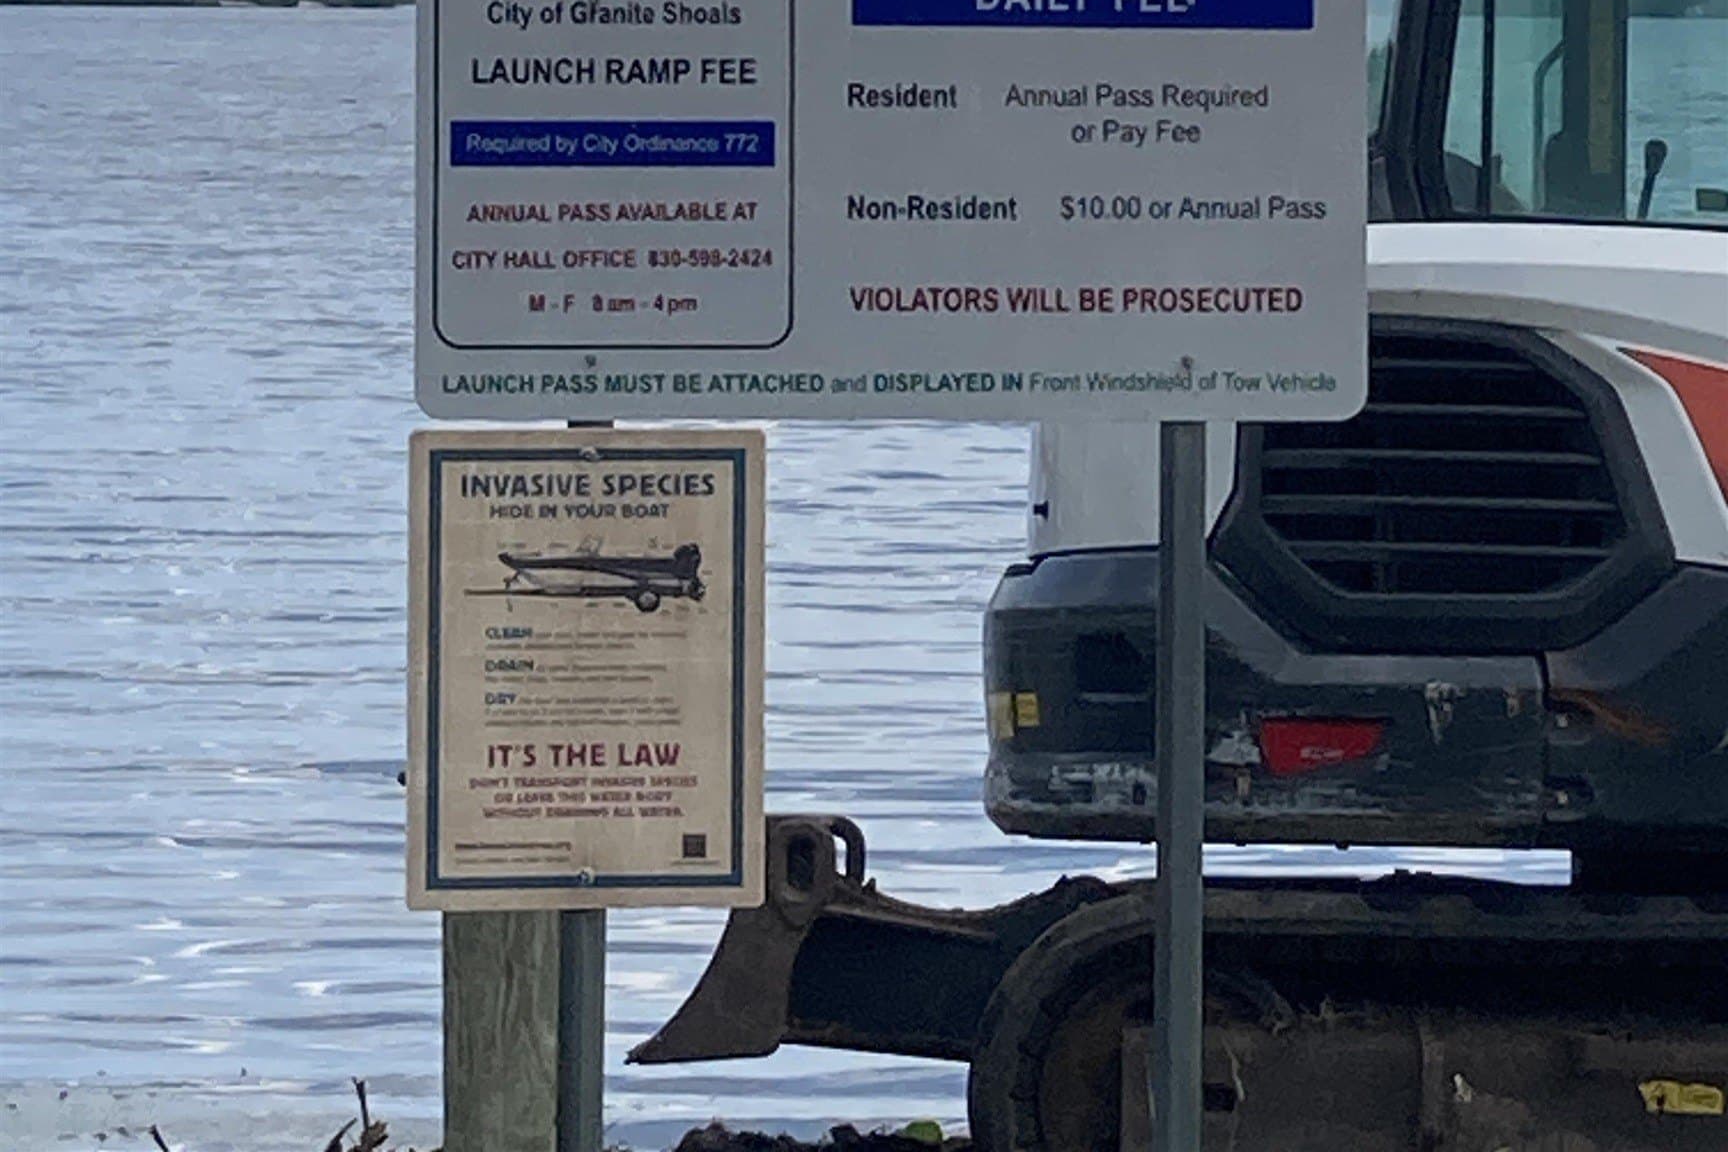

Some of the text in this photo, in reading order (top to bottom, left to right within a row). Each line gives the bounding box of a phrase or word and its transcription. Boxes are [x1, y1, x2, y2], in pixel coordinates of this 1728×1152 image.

[487, 0, 741, 30] City of Granite Shoals
[471, 58, 757, 85] LAUNCH RAMP FEE
[847, 82, 957, 109] Resident
[1005, 83, 1269, 114] Annual Pass Required
[466, 132, 760, 156] Required by City Ordinance 772
[1071, 121, 1201, 149] or Pay Fee
[466, 202, 758, 223] ANNUAL PASS AVAILABLE AT
[847, 195, 1018, 220] Non-Resident
[1060, 194, 1327, 221] $10.00 or Annual Pass
[452, 250, 497, 270] CITY
[504, 250, 556, 269] HALL
[562, 250, 636, 269] OFFICE
[563, 294, 576, 314] F
[849, 286, 1304, 314] VIOLATORS WILL BE PROSECUTED
[442, 373, 535, 394] LAUNCH
[541, 373, 598, 394] PASS
[603, 373, 667, 394] MUST
[672, 373, 703, 393] BE
[707, 373, 824, 393] ATTACHED
[831, 373, 867, 393] and
[873, 372, 996, 392] DISPLAYED
[1001, 372, 1023, 392] IN
[1030, 371, 1081, 392] Front
[1198, 370, 1219, 392] of
[1222, 371, 1262, 392] Tow
[461, 473, 715, 498] INVASIVE SPECIES
[564, 503, 617, 519] YOUR
[621, 503, 670, 518] BOAT
[487, 742, 682, 768] IT'S THE LAW
